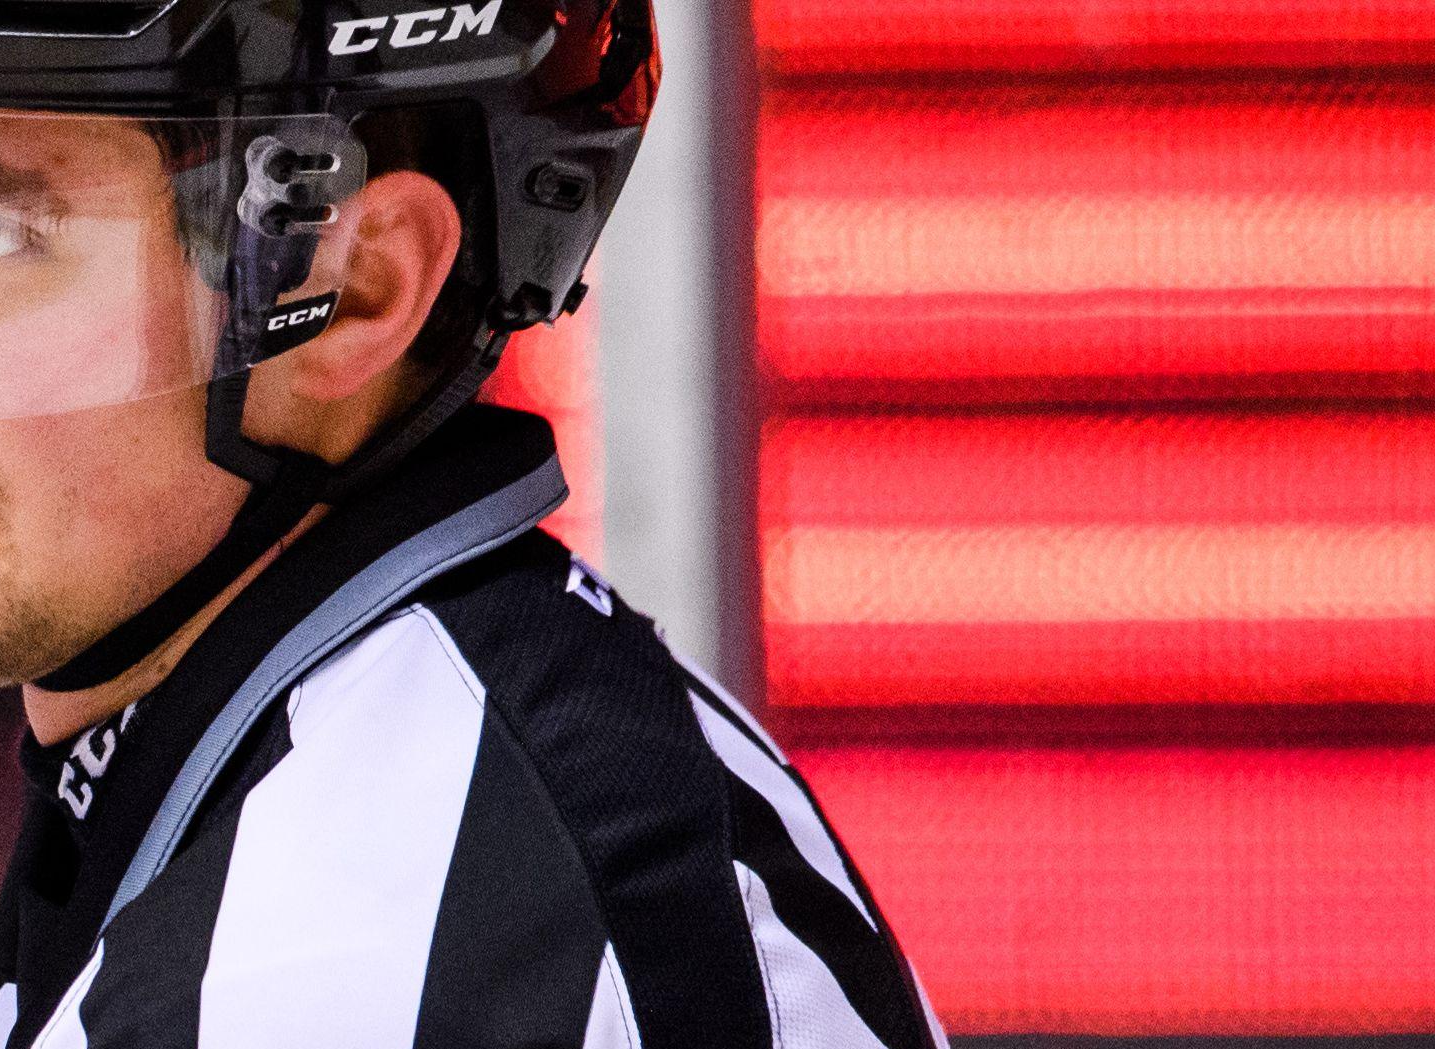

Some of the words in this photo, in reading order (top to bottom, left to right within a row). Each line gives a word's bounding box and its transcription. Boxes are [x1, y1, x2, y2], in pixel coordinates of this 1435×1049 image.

[328, 0, 503, 56] CCM
[265, 300, 330, 333] CCM
[58, 700, 138, 820] CC
